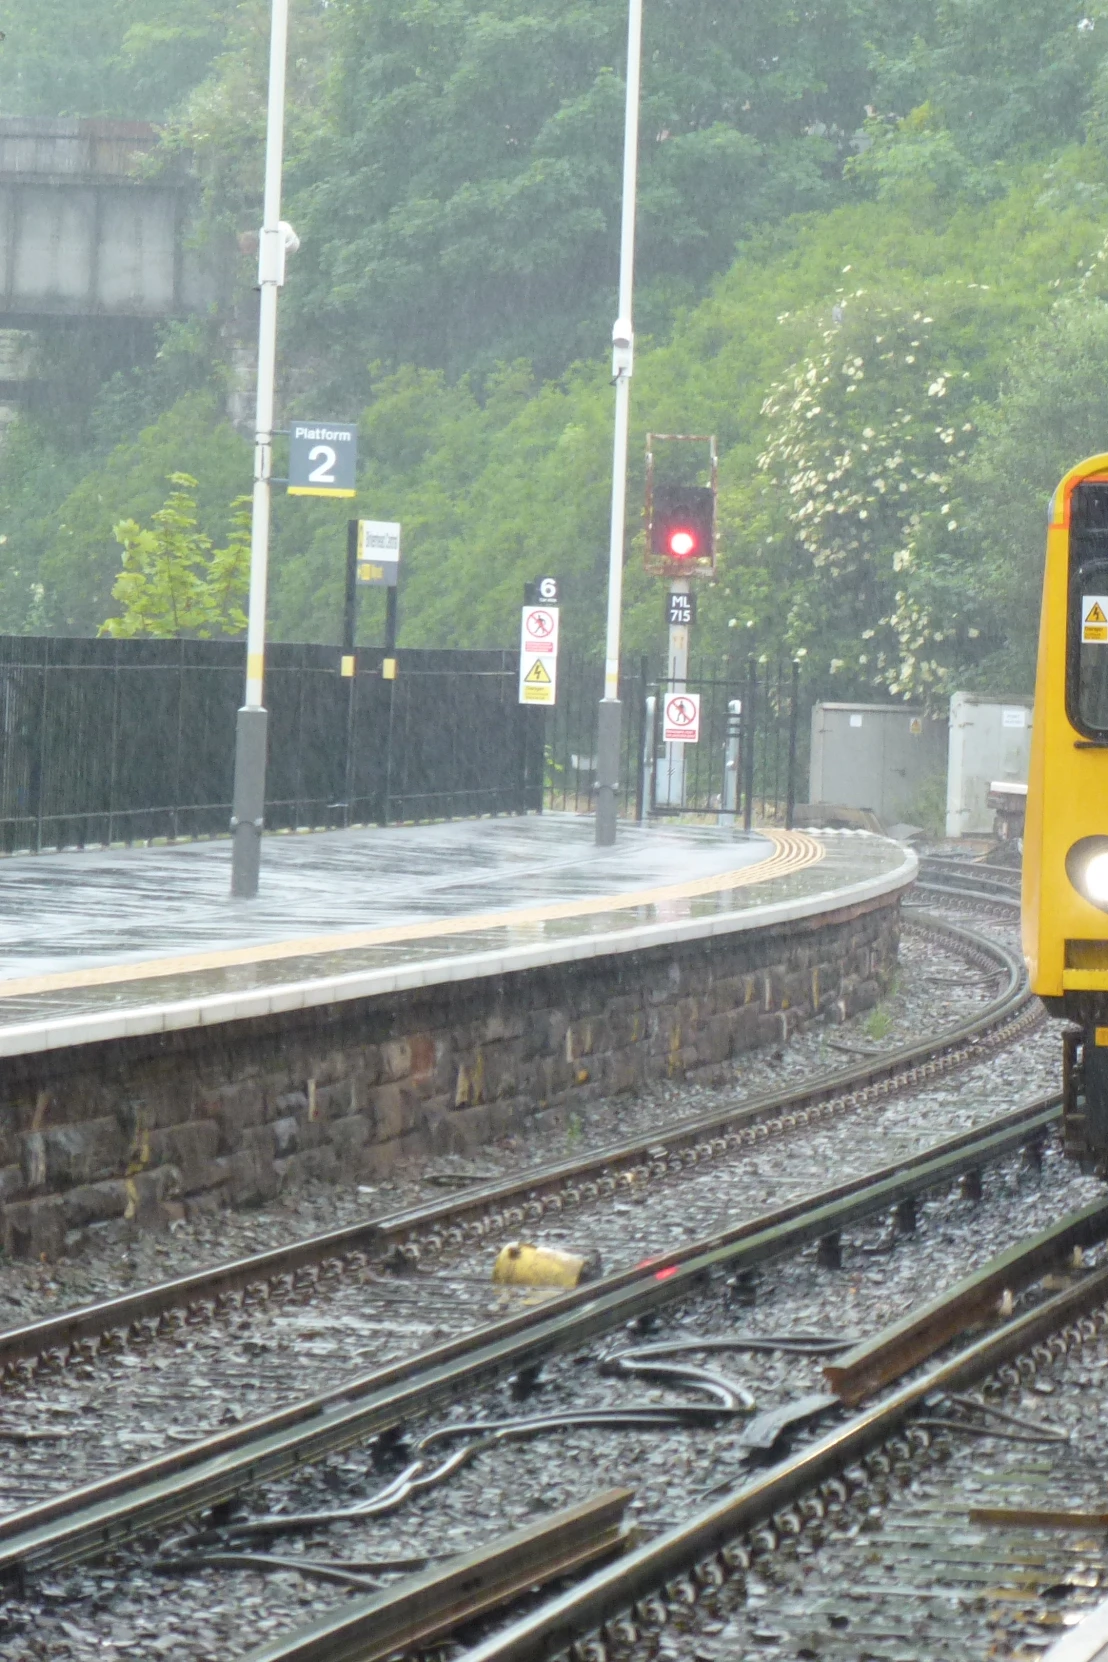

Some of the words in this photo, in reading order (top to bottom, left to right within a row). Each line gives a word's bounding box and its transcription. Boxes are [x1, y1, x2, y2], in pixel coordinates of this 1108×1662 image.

[295, 427, 351, 441] Platform
[308, 445, 336, 483] 2
[540, 578, 556, 598] 6
[671, 595, 691, 608] ML
[670, 609, 691, 622] 715
